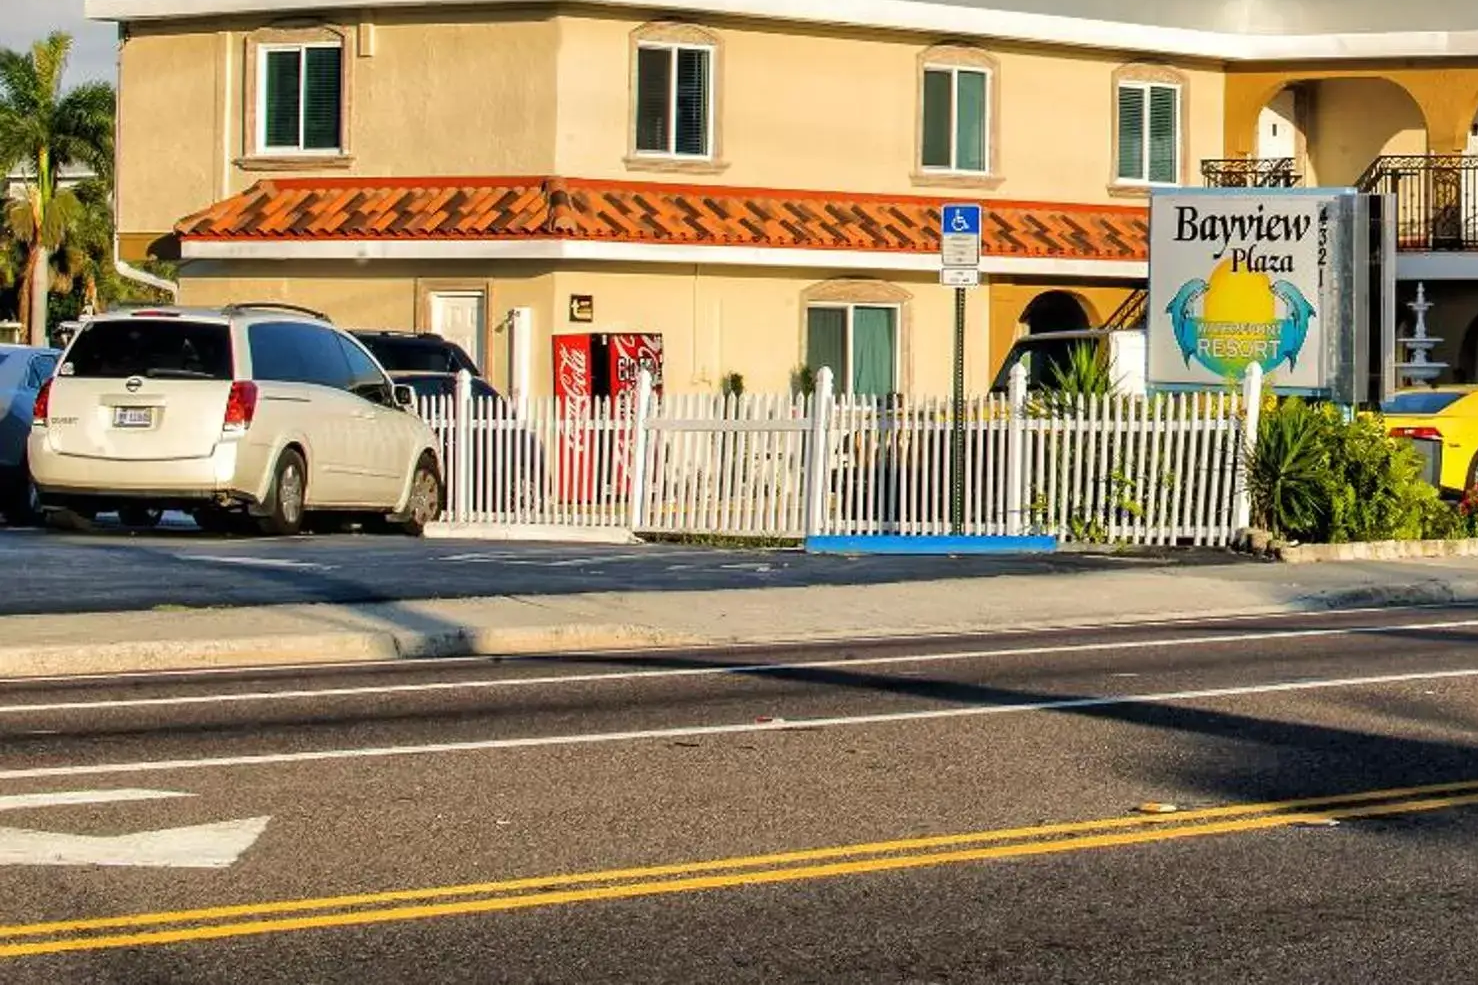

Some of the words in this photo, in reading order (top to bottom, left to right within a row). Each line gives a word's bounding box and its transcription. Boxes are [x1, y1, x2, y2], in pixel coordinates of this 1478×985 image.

[1173, 203, 1311, 259] Bayview
[1230, 245, 1294, 273] Plaza
[1197, 338, 1281, 360] RESORT
